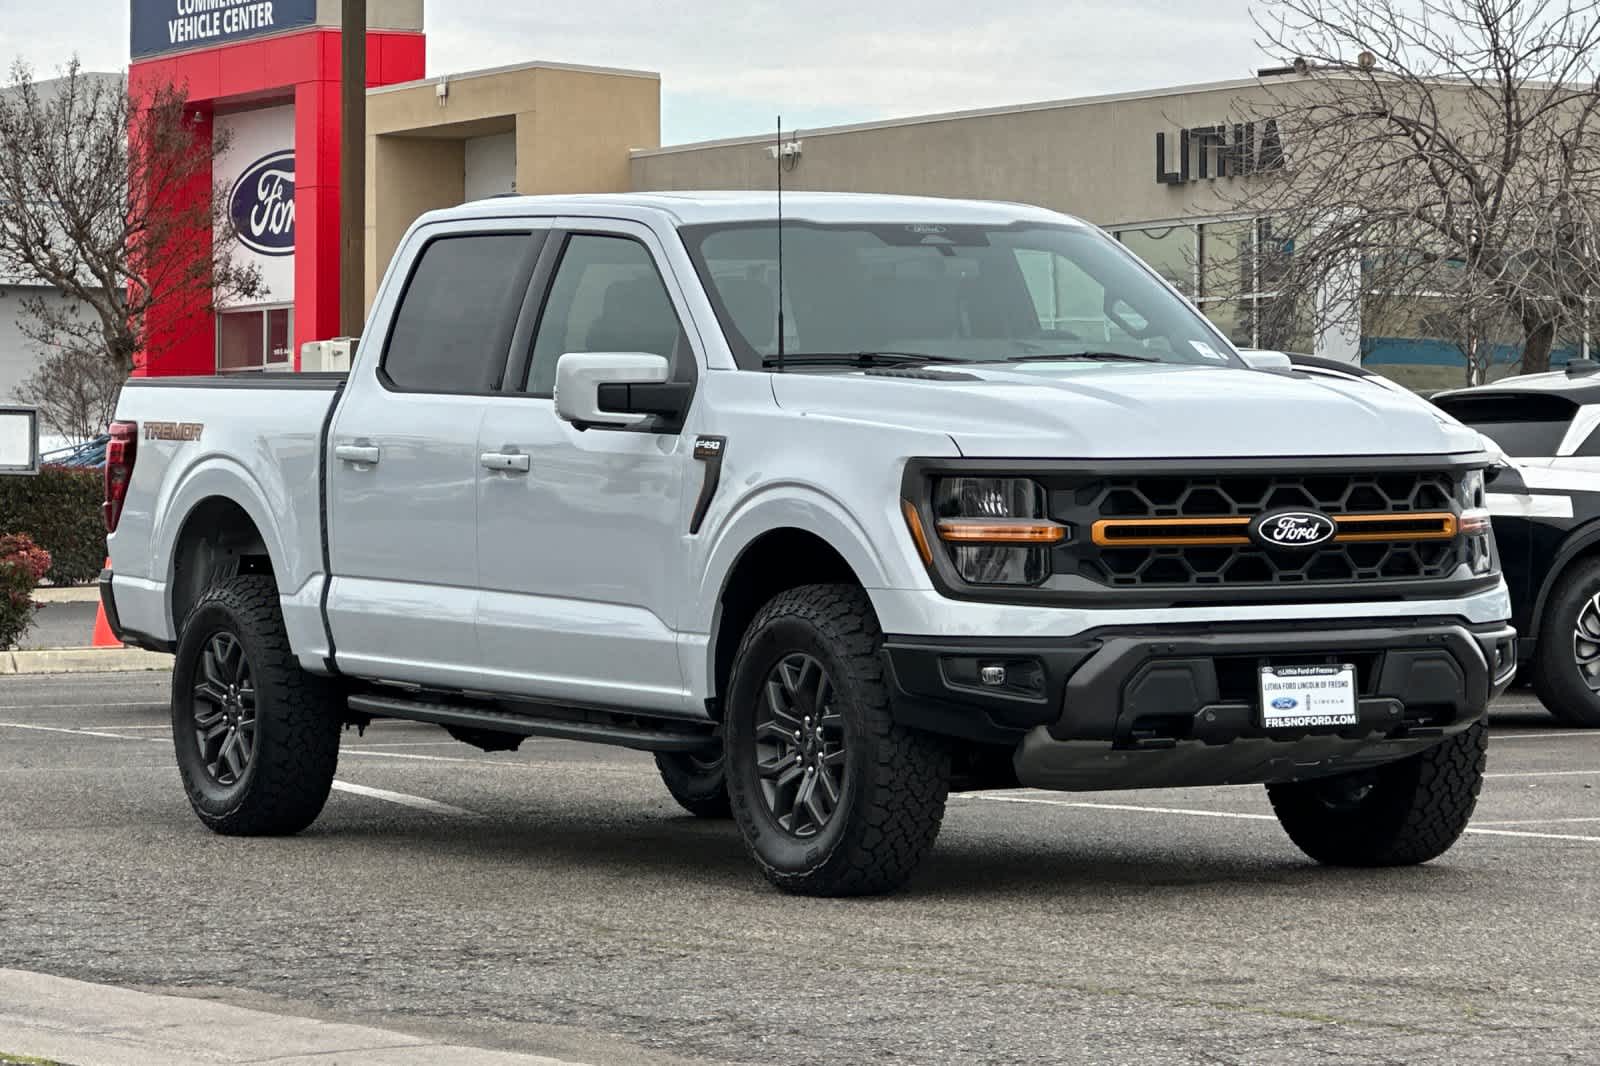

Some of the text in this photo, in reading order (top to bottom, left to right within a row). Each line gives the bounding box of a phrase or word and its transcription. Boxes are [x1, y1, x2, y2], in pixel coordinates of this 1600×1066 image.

[168, 11, 220, 43] VEHICLE
[223, 1, 274, 33] CENTER
[1156, 119, 1285, 184] LITHIA
[250, 169, 296, 237] For
[143, 422, 204, 441] TREMOR
[1273, 517, 1320, 540] Ford
[1264, 682, 1282, 691] LITHIA
[1283, 682, 1297, 690] FORD
[1298, 681, 1320, 689] LINCOLN
[1328, 680, 1349, 688] FRESNO
[1265, 716, 1356, 728] FRESNOFORD.COM
